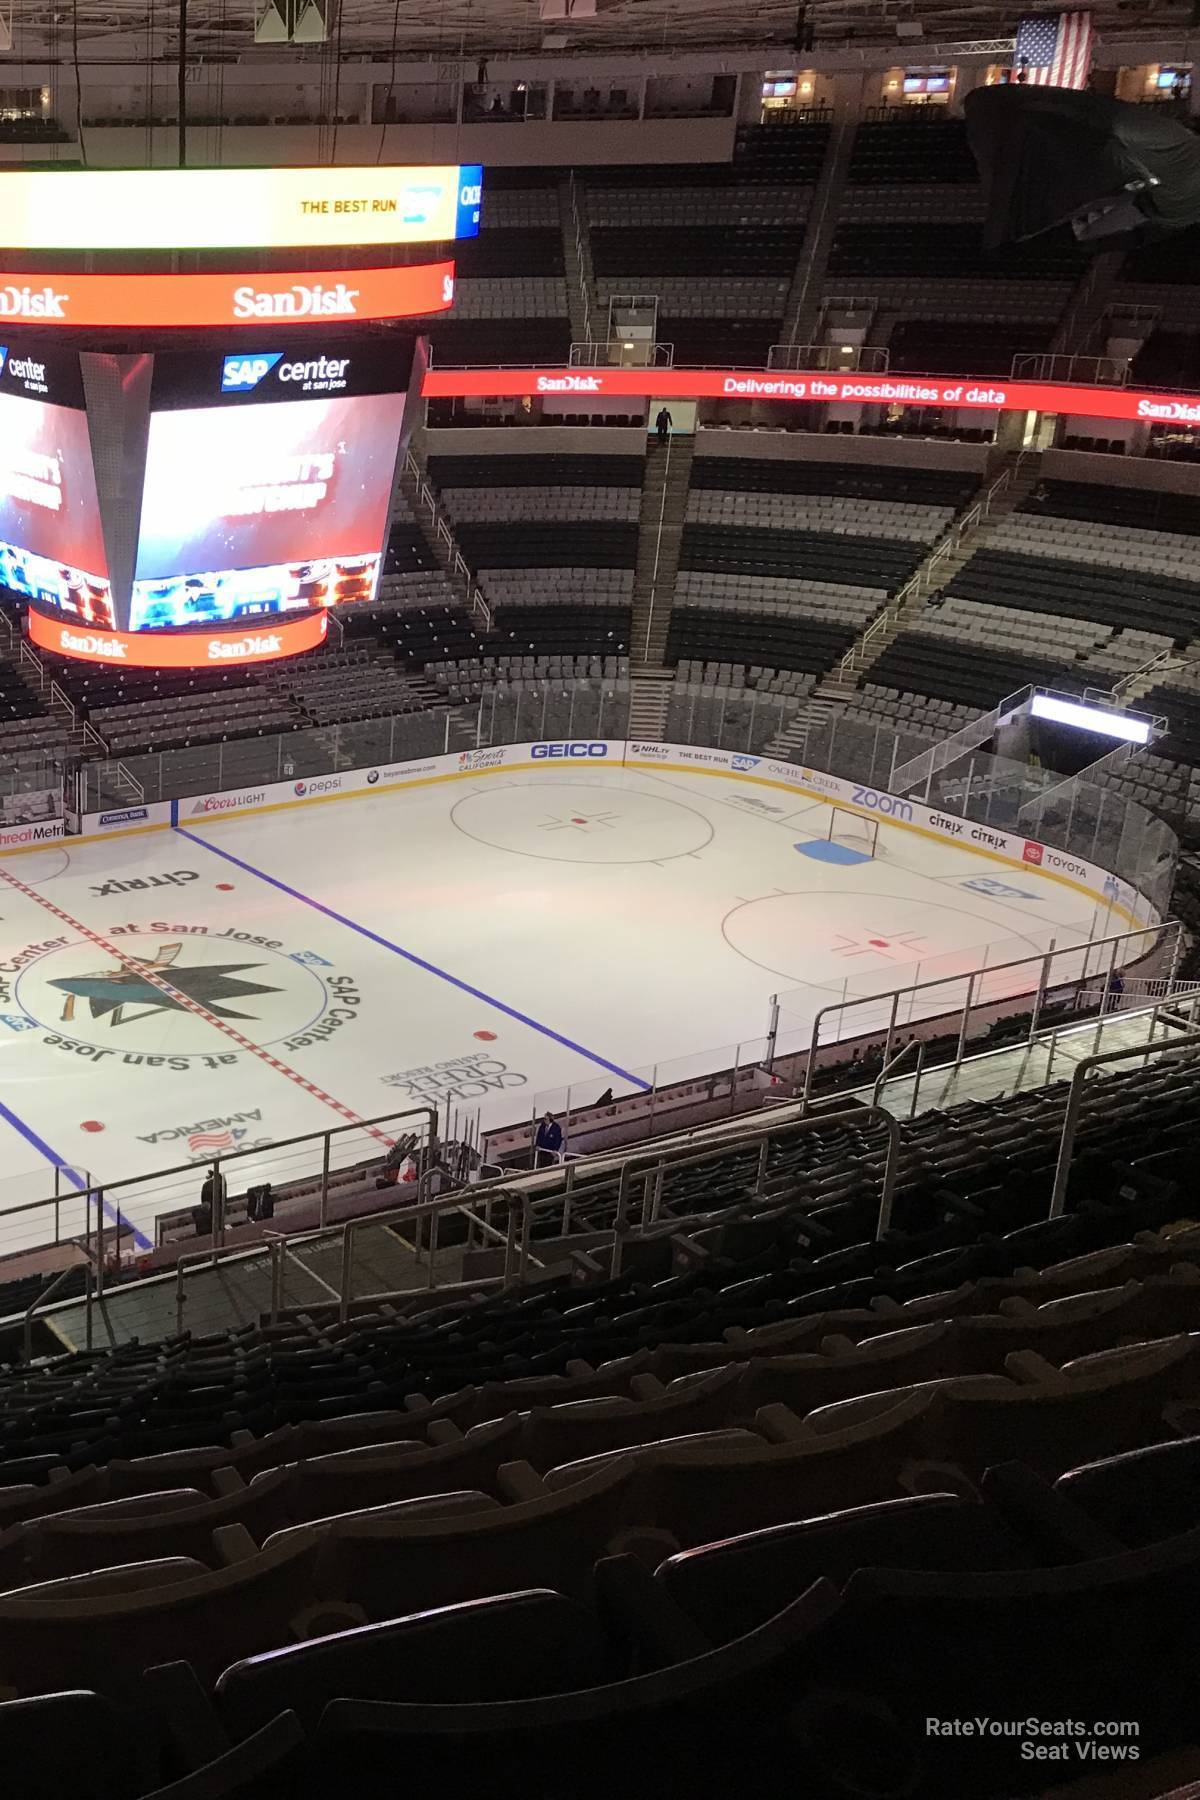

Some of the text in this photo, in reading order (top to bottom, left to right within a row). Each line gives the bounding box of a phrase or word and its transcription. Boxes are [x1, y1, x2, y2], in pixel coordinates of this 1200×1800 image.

[301, 199, 397, 214] THE BEST RUN
[233, 284, 359, 317] SanDisk
[8, 357, 45, 381] center
[223, 355, 350, 386] SAP center
[302, 379, 347, 391] at san jose
[536, 376, 603, 392] SanDisk
[723, 378, 1006, 404] Delivering the possibilities of data
[1137, 399, 1200, 421] SanDis
[61, 630, 128, 658] SanDisk
[208, 635, 283, 659] SanDisk
[531, 743, 608, 759] GEICO
[679, 751, 693, 760] THE
[693, 752, 711, 762] BEST
[713, 754, 729, 764] RUN
[732, 756, 755, 769] SAP
[459, 760, 502, 772] CALIFORNIA
[308, 777, 342, 795] pepsi
[204, 792, 266, 812] Coors LIGHT
[851, 786, 913, 822] zoom
[1047, 853, 1087, 879] TOYOTA
[109, 922, 141, 935] at
[150, 921, 209, 935] San
[224, 926, 284, 949] Jose
[42, 975, 362, 1071] SAP Center at San Jose
[379, 1052, 490, 1084] CASINO RESORT
[388, 1060, 507, 1096] CREEK
[135, 1108, 262, 1144] AMERICA
